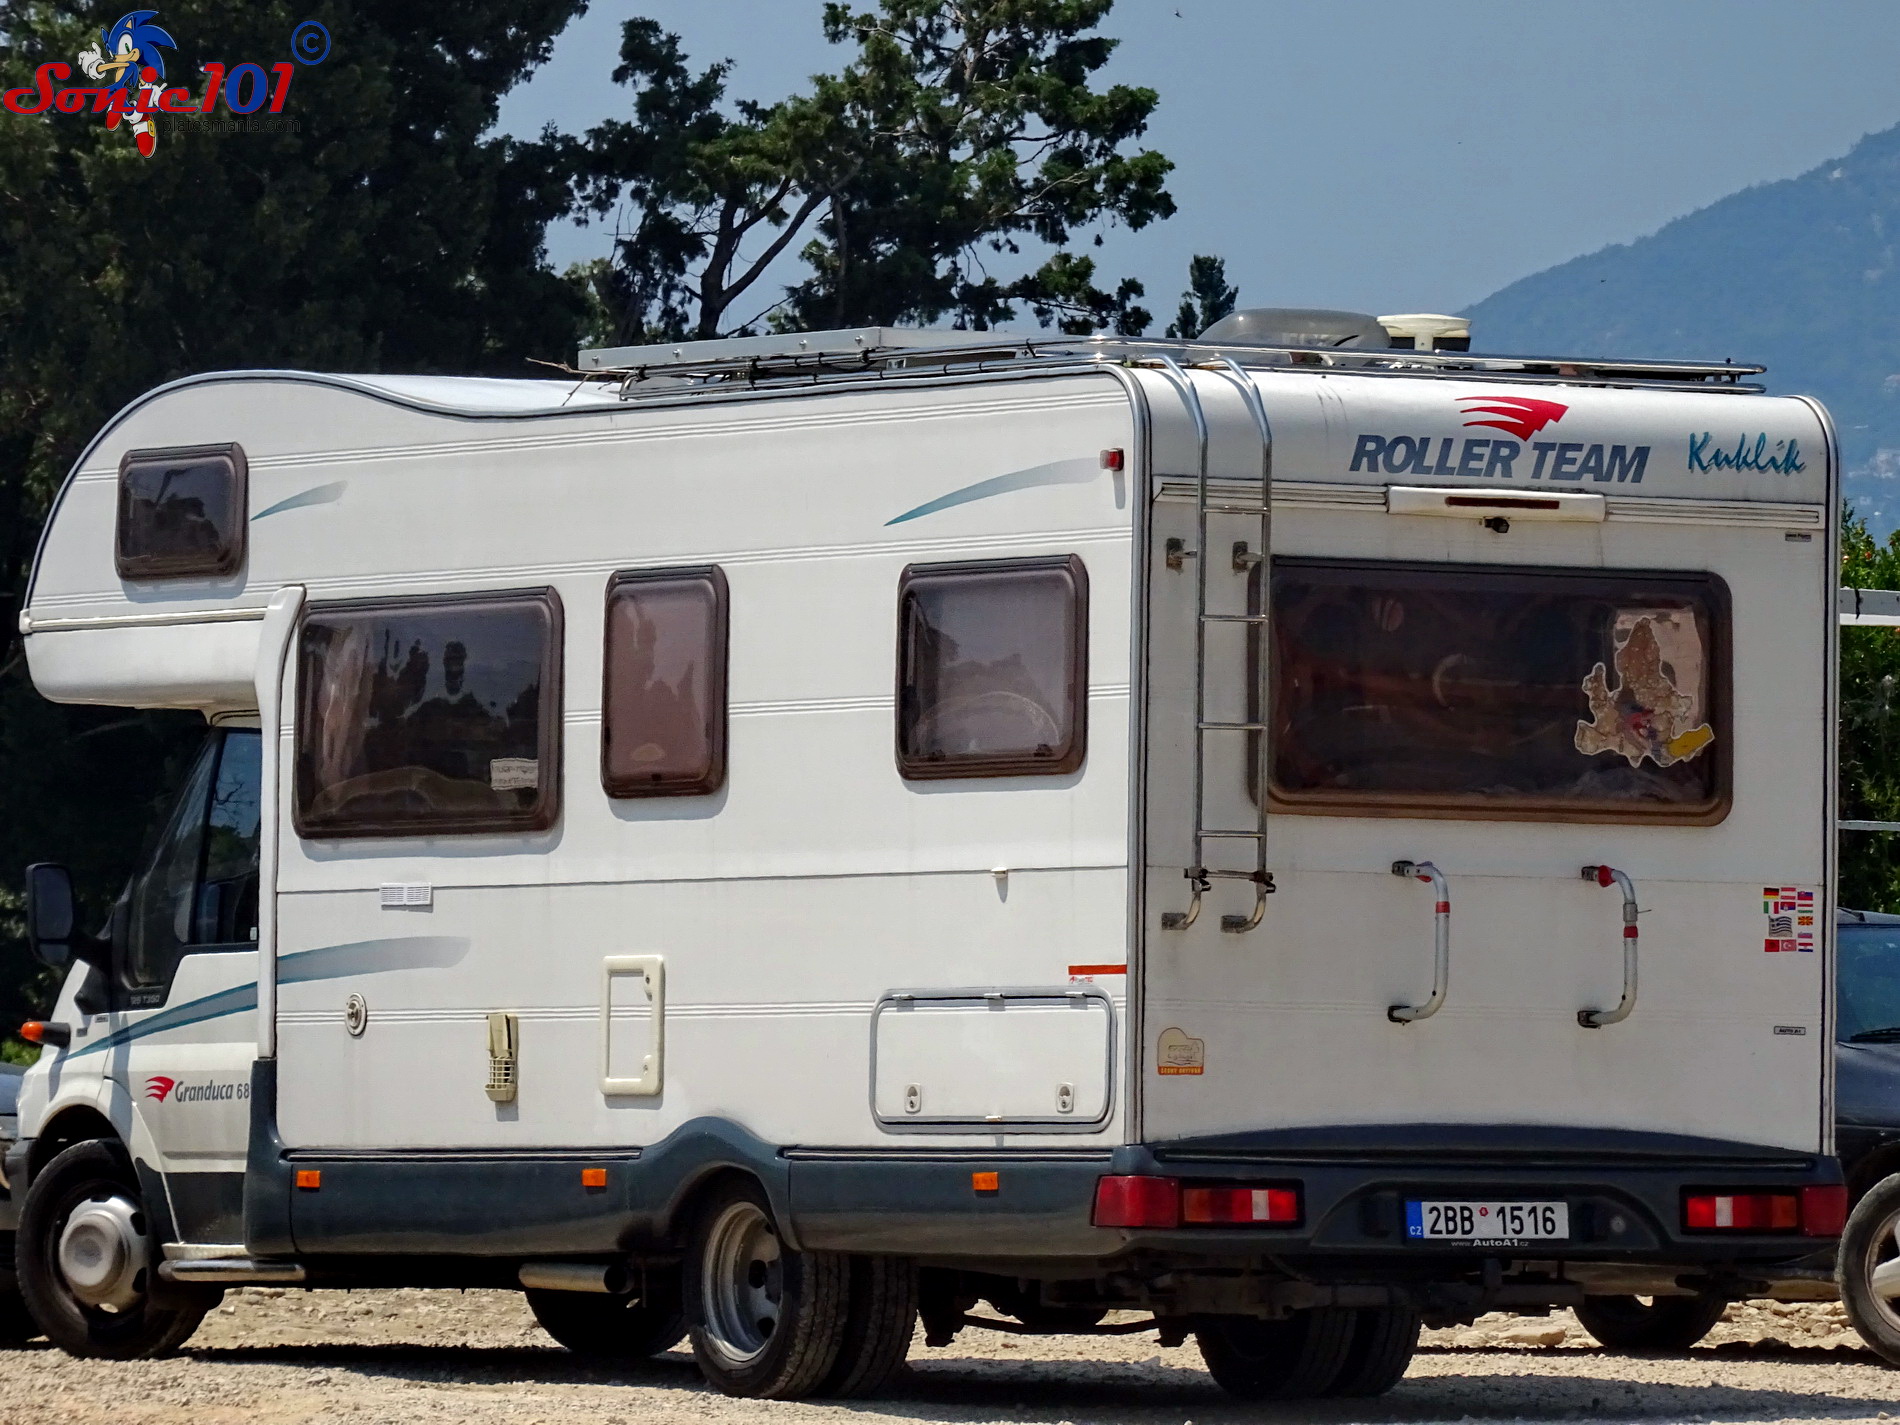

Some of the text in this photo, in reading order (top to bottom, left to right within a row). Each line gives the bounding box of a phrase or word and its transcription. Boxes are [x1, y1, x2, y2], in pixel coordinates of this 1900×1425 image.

[1349, 434, 1650, 483] ROLLER TEAM
[175, 1080, 249, 1102] Granduca 68
[1409, 1226, 1422, 1236] CZ
[1428, 1206, 1556, 1235] 2BB 1516
